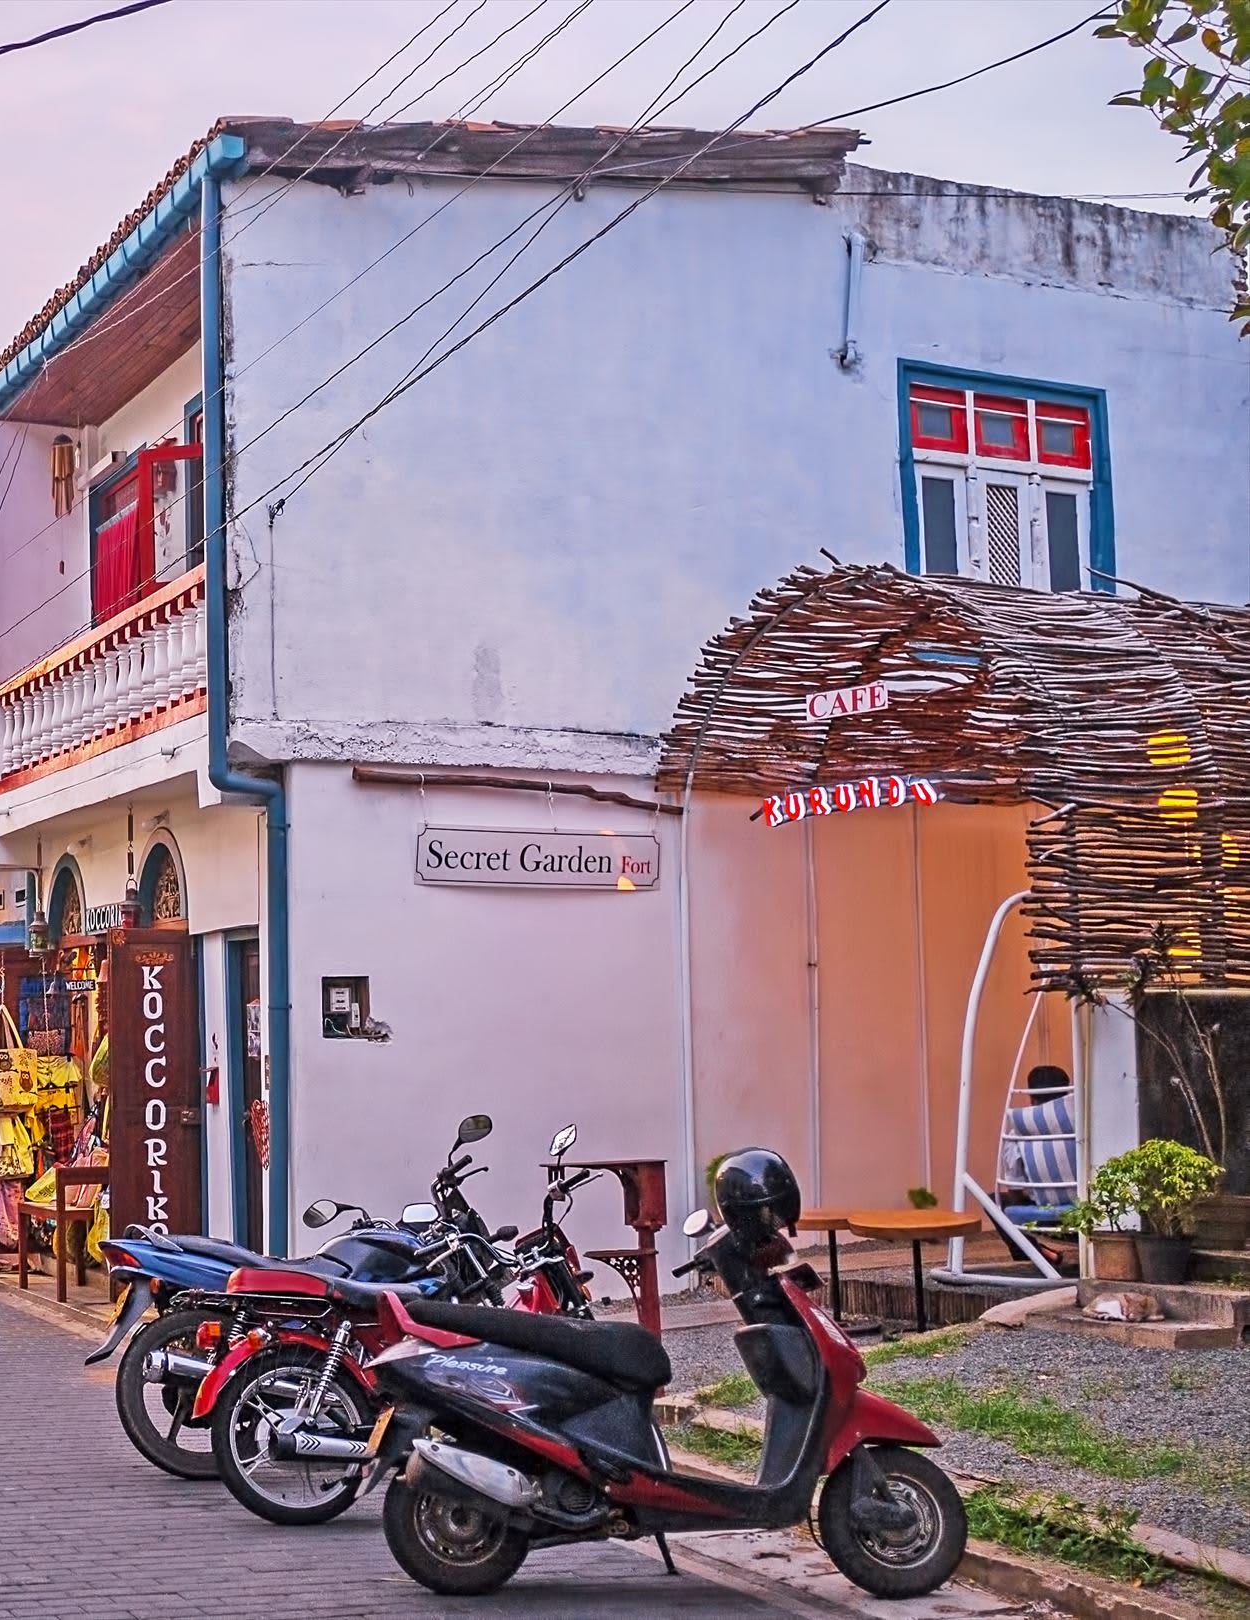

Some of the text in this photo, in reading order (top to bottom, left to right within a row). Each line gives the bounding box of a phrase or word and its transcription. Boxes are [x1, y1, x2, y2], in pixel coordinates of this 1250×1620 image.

[763, 775, 938, 827] KURUNDU
[426, 839, 651, 874] Secret Garden Fort
[65, 980, 94, 991] WELCOME
[423, 1354, 508, 1375] Pleasure
